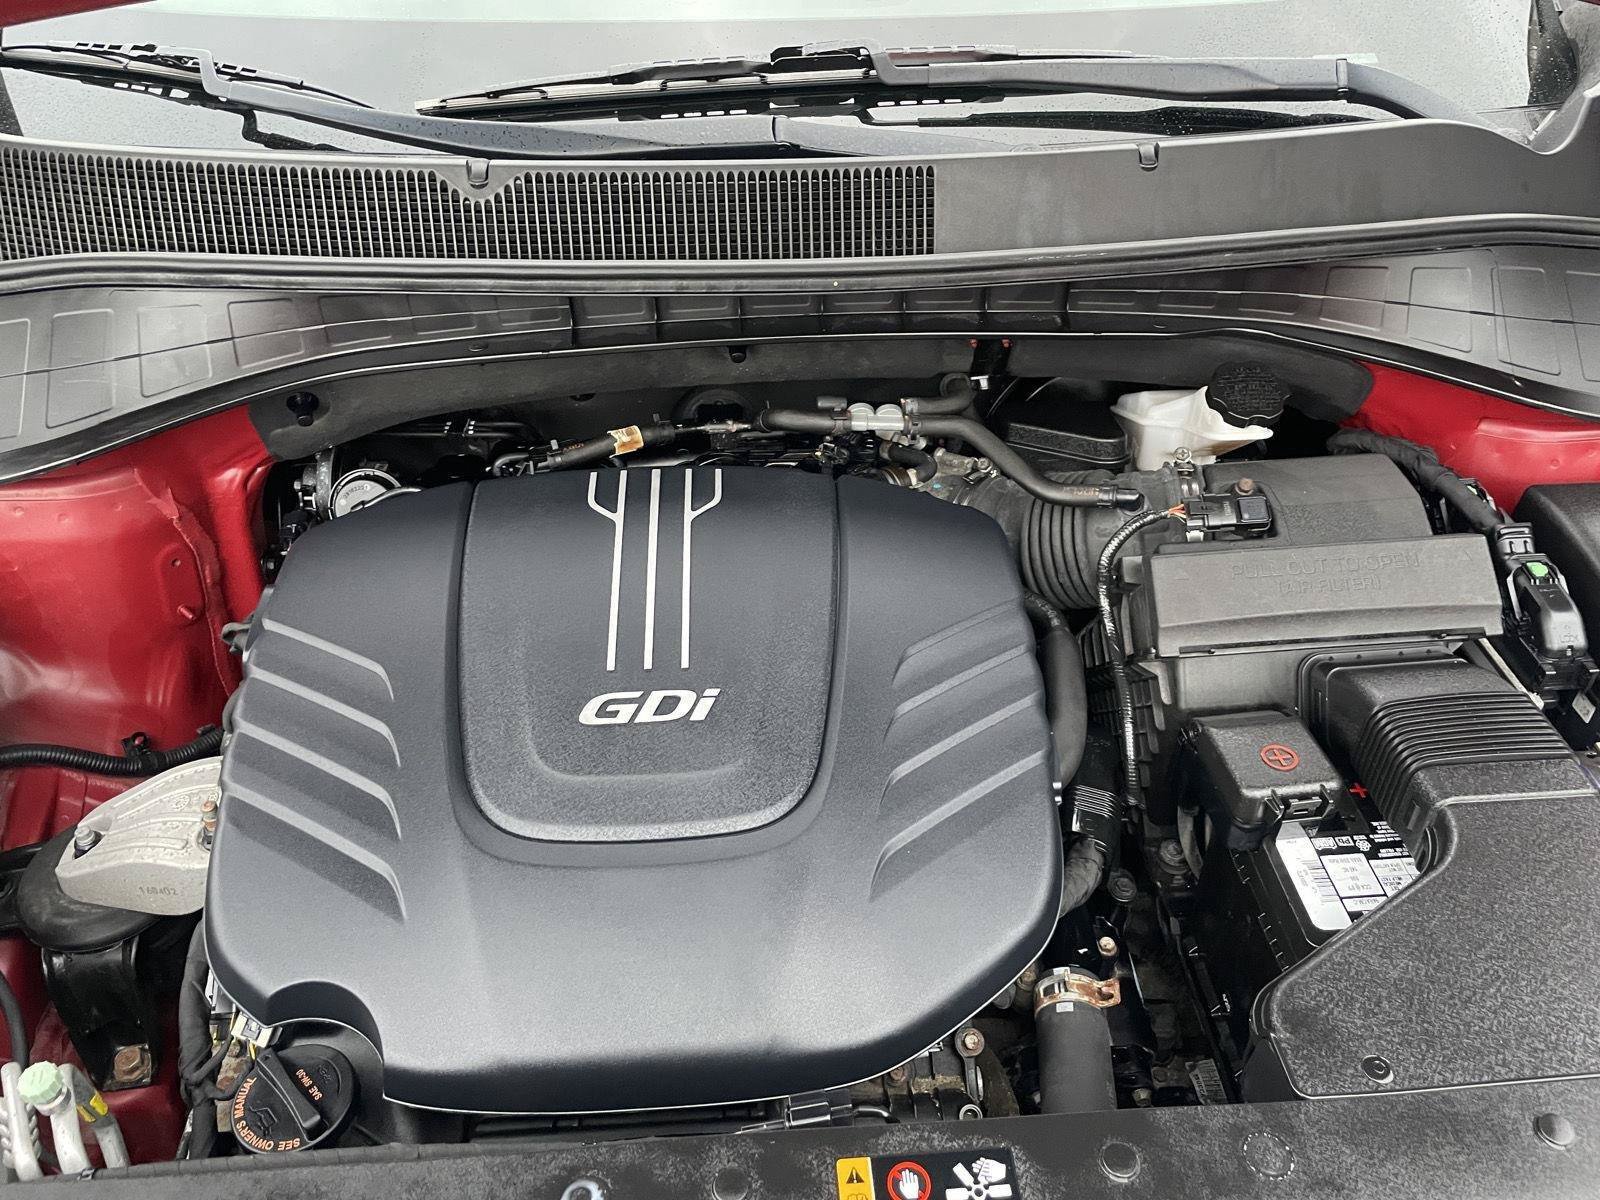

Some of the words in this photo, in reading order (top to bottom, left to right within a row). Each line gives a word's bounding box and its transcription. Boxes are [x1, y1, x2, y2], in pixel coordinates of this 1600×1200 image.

[1231, 565, 1283, 579] PULL
[1287, 558, 1328, 576] OUT
[1331, 557, 1360, 573] TO
[1365, 552, 1421, 571] OPEN
[578, 687, 721, 725] GDi
[295, 1068, 313, 1087] 5W-30
[233, 1076, 258, 1119] MANUAL
[308, 1085, 323, 1101] SAE
[236, 1120, 275, 1151] OWNER'S
[277, 1137, 301, 1151] SEE
